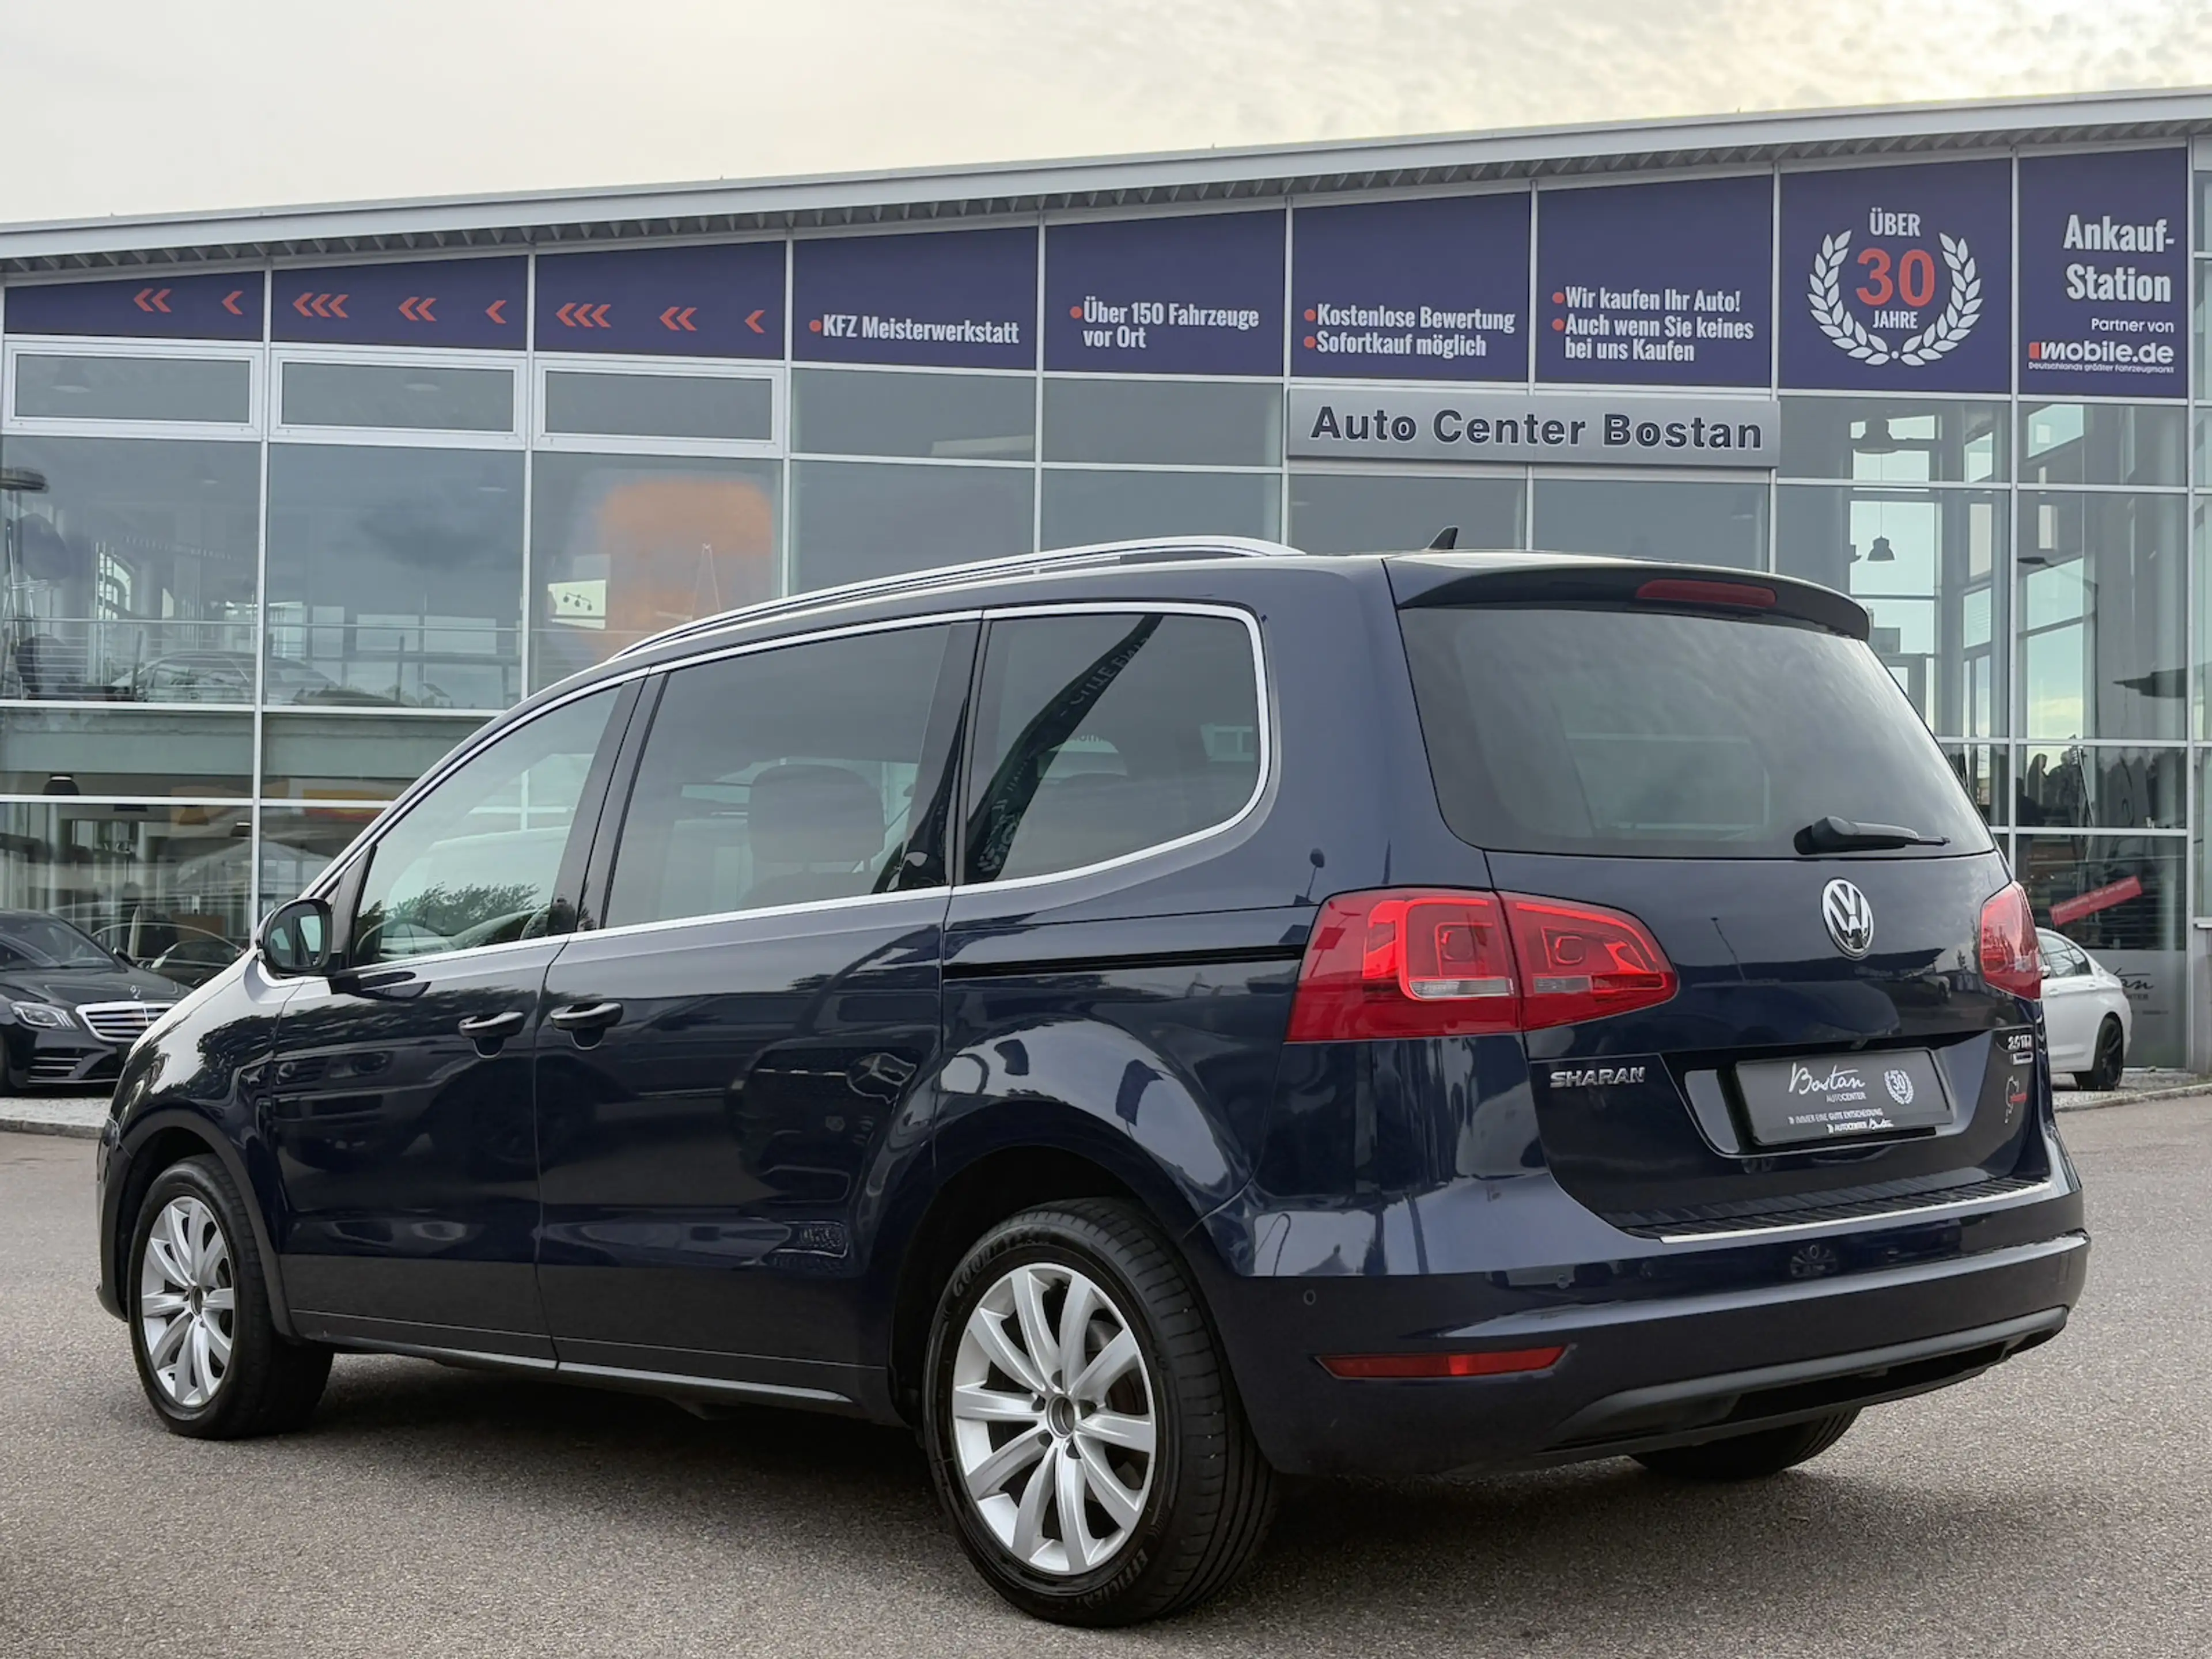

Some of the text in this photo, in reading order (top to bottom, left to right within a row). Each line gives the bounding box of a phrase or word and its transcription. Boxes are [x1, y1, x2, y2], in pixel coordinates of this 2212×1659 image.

[1870, 207, 1921, 237] ÜBER
[2063, 214, 2175, 252] Ankauf-
[1857, 248, 1935, 307] 30
[2066, 263, 2171, 302] Station
[1084, 296, 1259, 331] Über 150 Fahrzeuge
[1565, 286, 1741, 312] Wir kaufen Ihr Auto!
[823, 314, 1020, 344] KFZ Meisterwerkstatt
[1317, 303, 1516, 334] Kostenlose Bewertung
[1565, 313, 1755, 340] Auch wenn Sie keines
[1872, 310, 1918, 329] JAHRE
[2091, 317, 2174, 333] Partner von
[1083, 325, 1146, 349] vor Ort
[1316, 330, 1487, 359] Sofortkauf möglich
[1565, 336, 1695, 362] bei uns Kaufen
[2028, 361, 2082, 372] Deutschlands
[2041, 340, 2175, 364] mobile.de
[1309, 406, 1762, 449] Auto Center Bostan
[1550, 1066, 1646, 1088] SHARAN
[1789, 1062, 1866, 1094] Bostan
